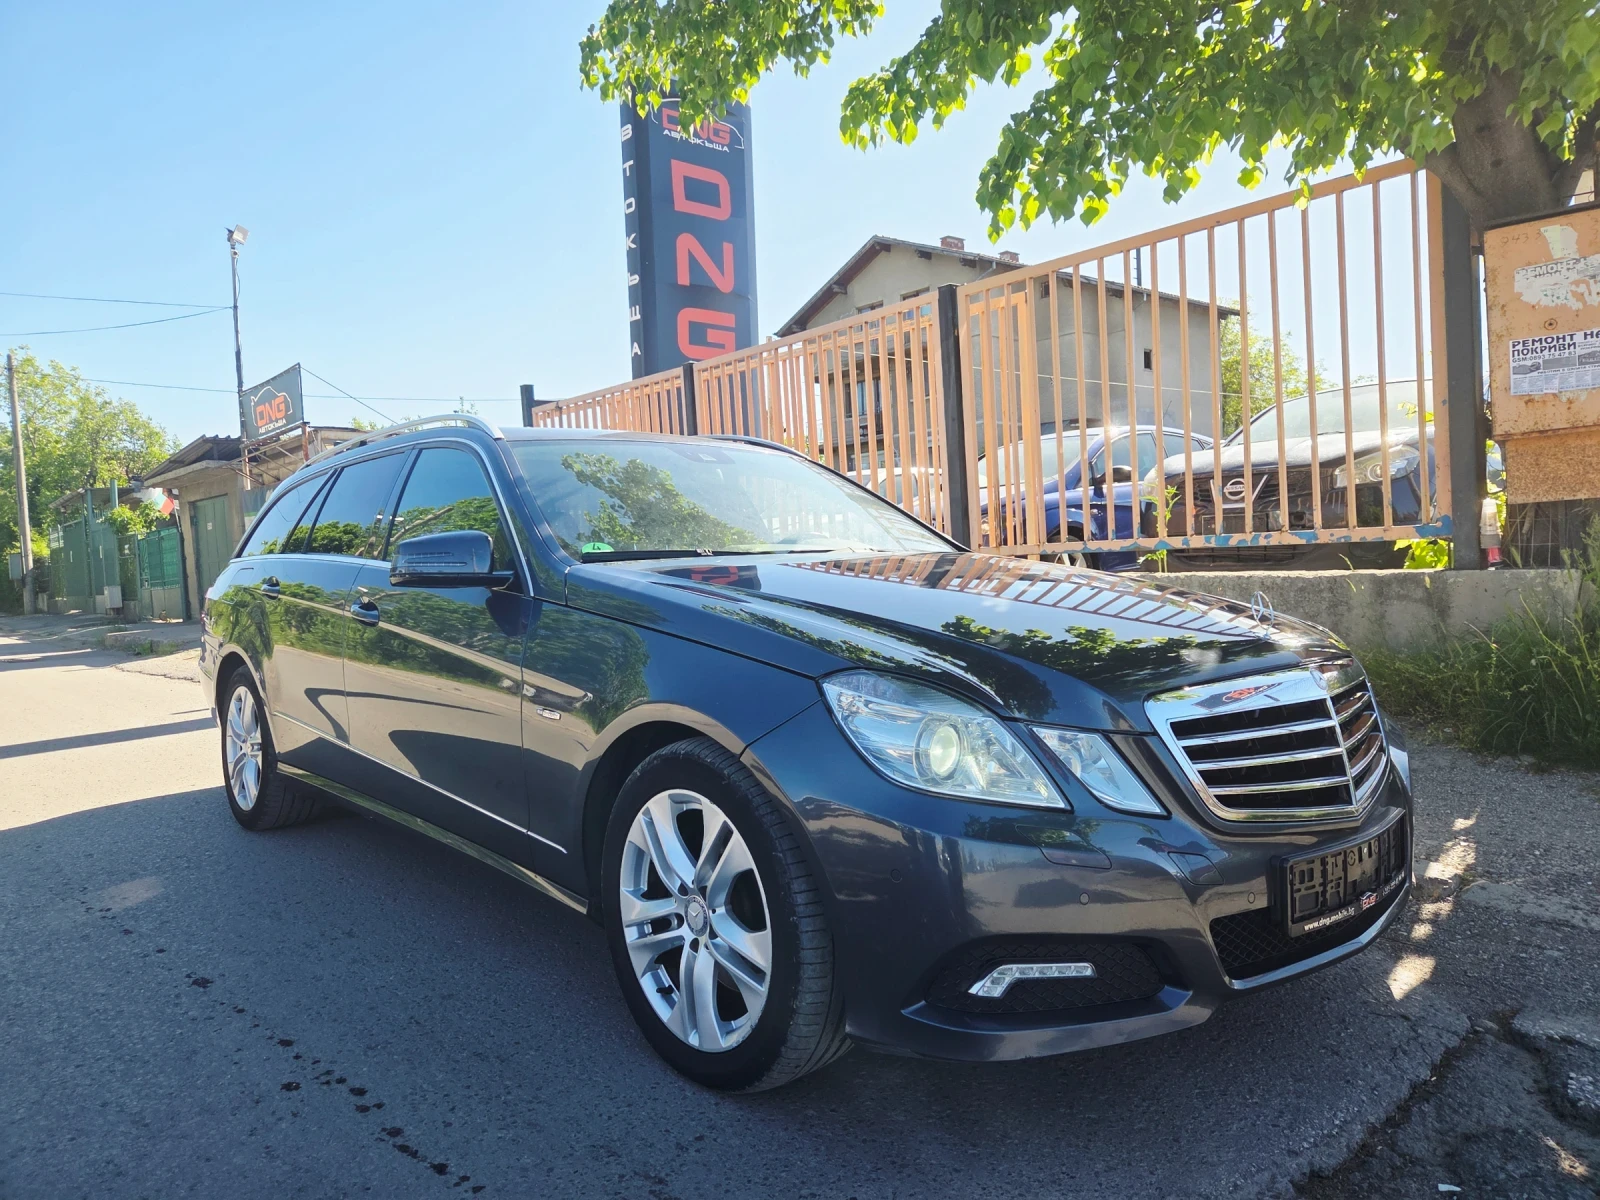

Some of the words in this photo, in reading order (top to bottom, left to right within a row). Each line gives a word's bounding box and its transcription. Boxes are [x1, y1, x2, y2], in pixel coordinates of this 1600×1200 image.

[620, 123, 642, 357] ВТОКЪЩА
[670, 158, 736, 361] DNG
[1511, 333, 1577, 349] РЕМОНТ
[1511, 341, 1577, 358] ПОКРИВИ
[256, 395, 285, 427] DNG
